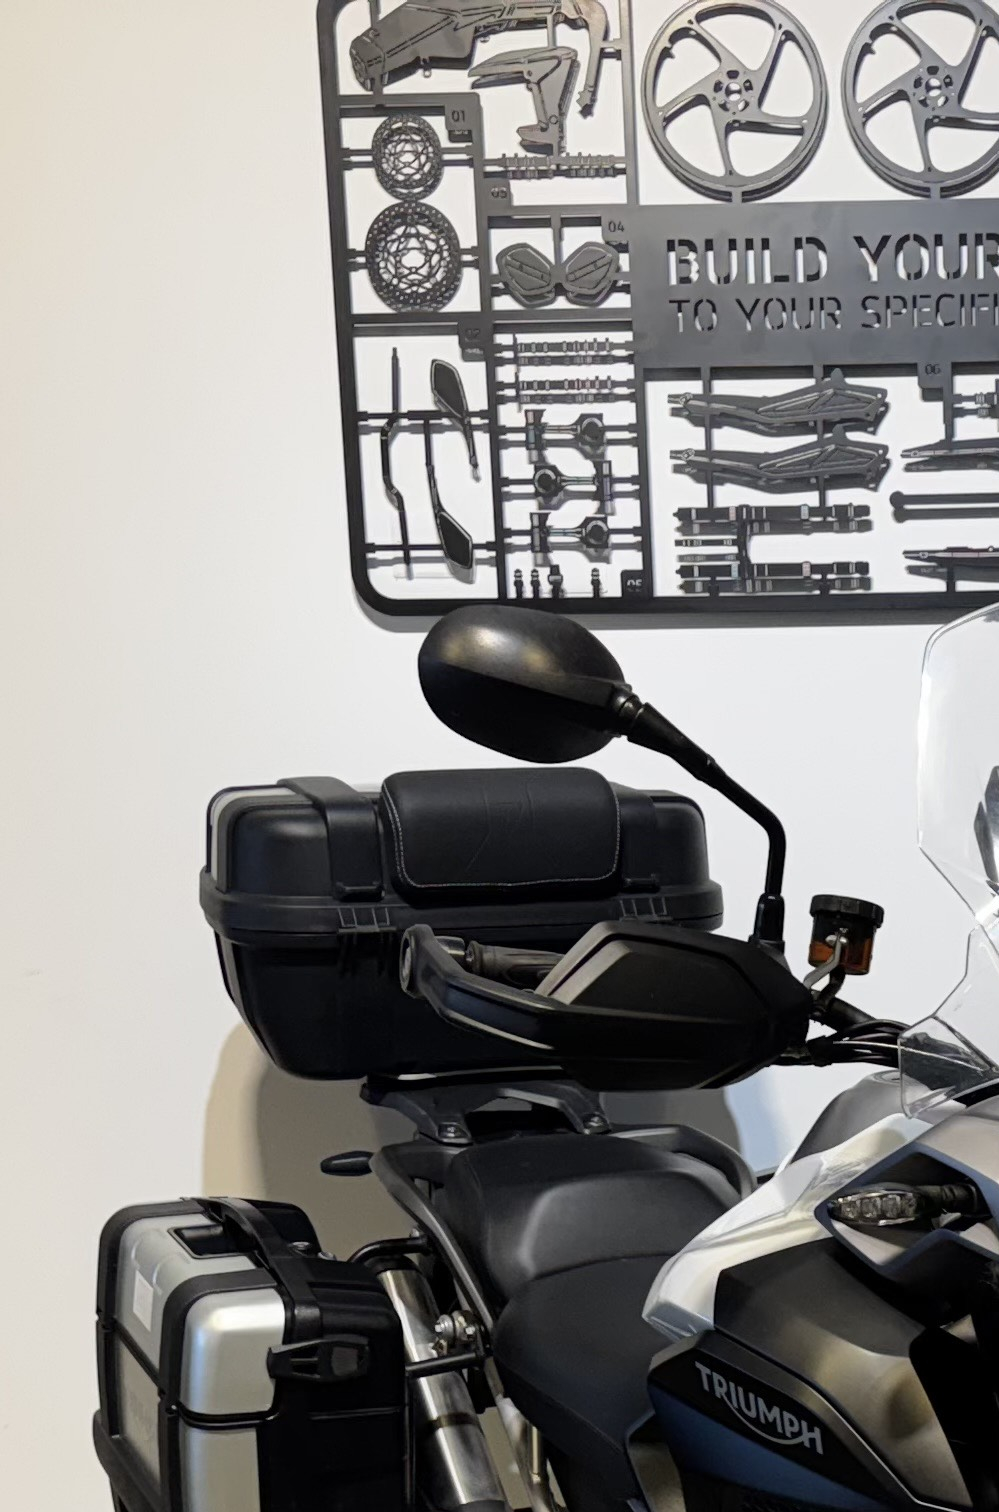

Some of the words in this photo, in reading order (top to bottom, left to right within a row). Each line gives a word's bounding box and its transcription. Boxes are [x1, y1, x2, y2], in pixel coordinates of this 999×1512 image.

[451, 110, 466, 123] 01
[608, 221, 625, 233] 04
[666, 237, 828, 285] BUILD
[669, 298, 718, 333] TO
[735, 296, 843, 332] YOUR
[695, 1360, 823, 1455] TRIUMPH
